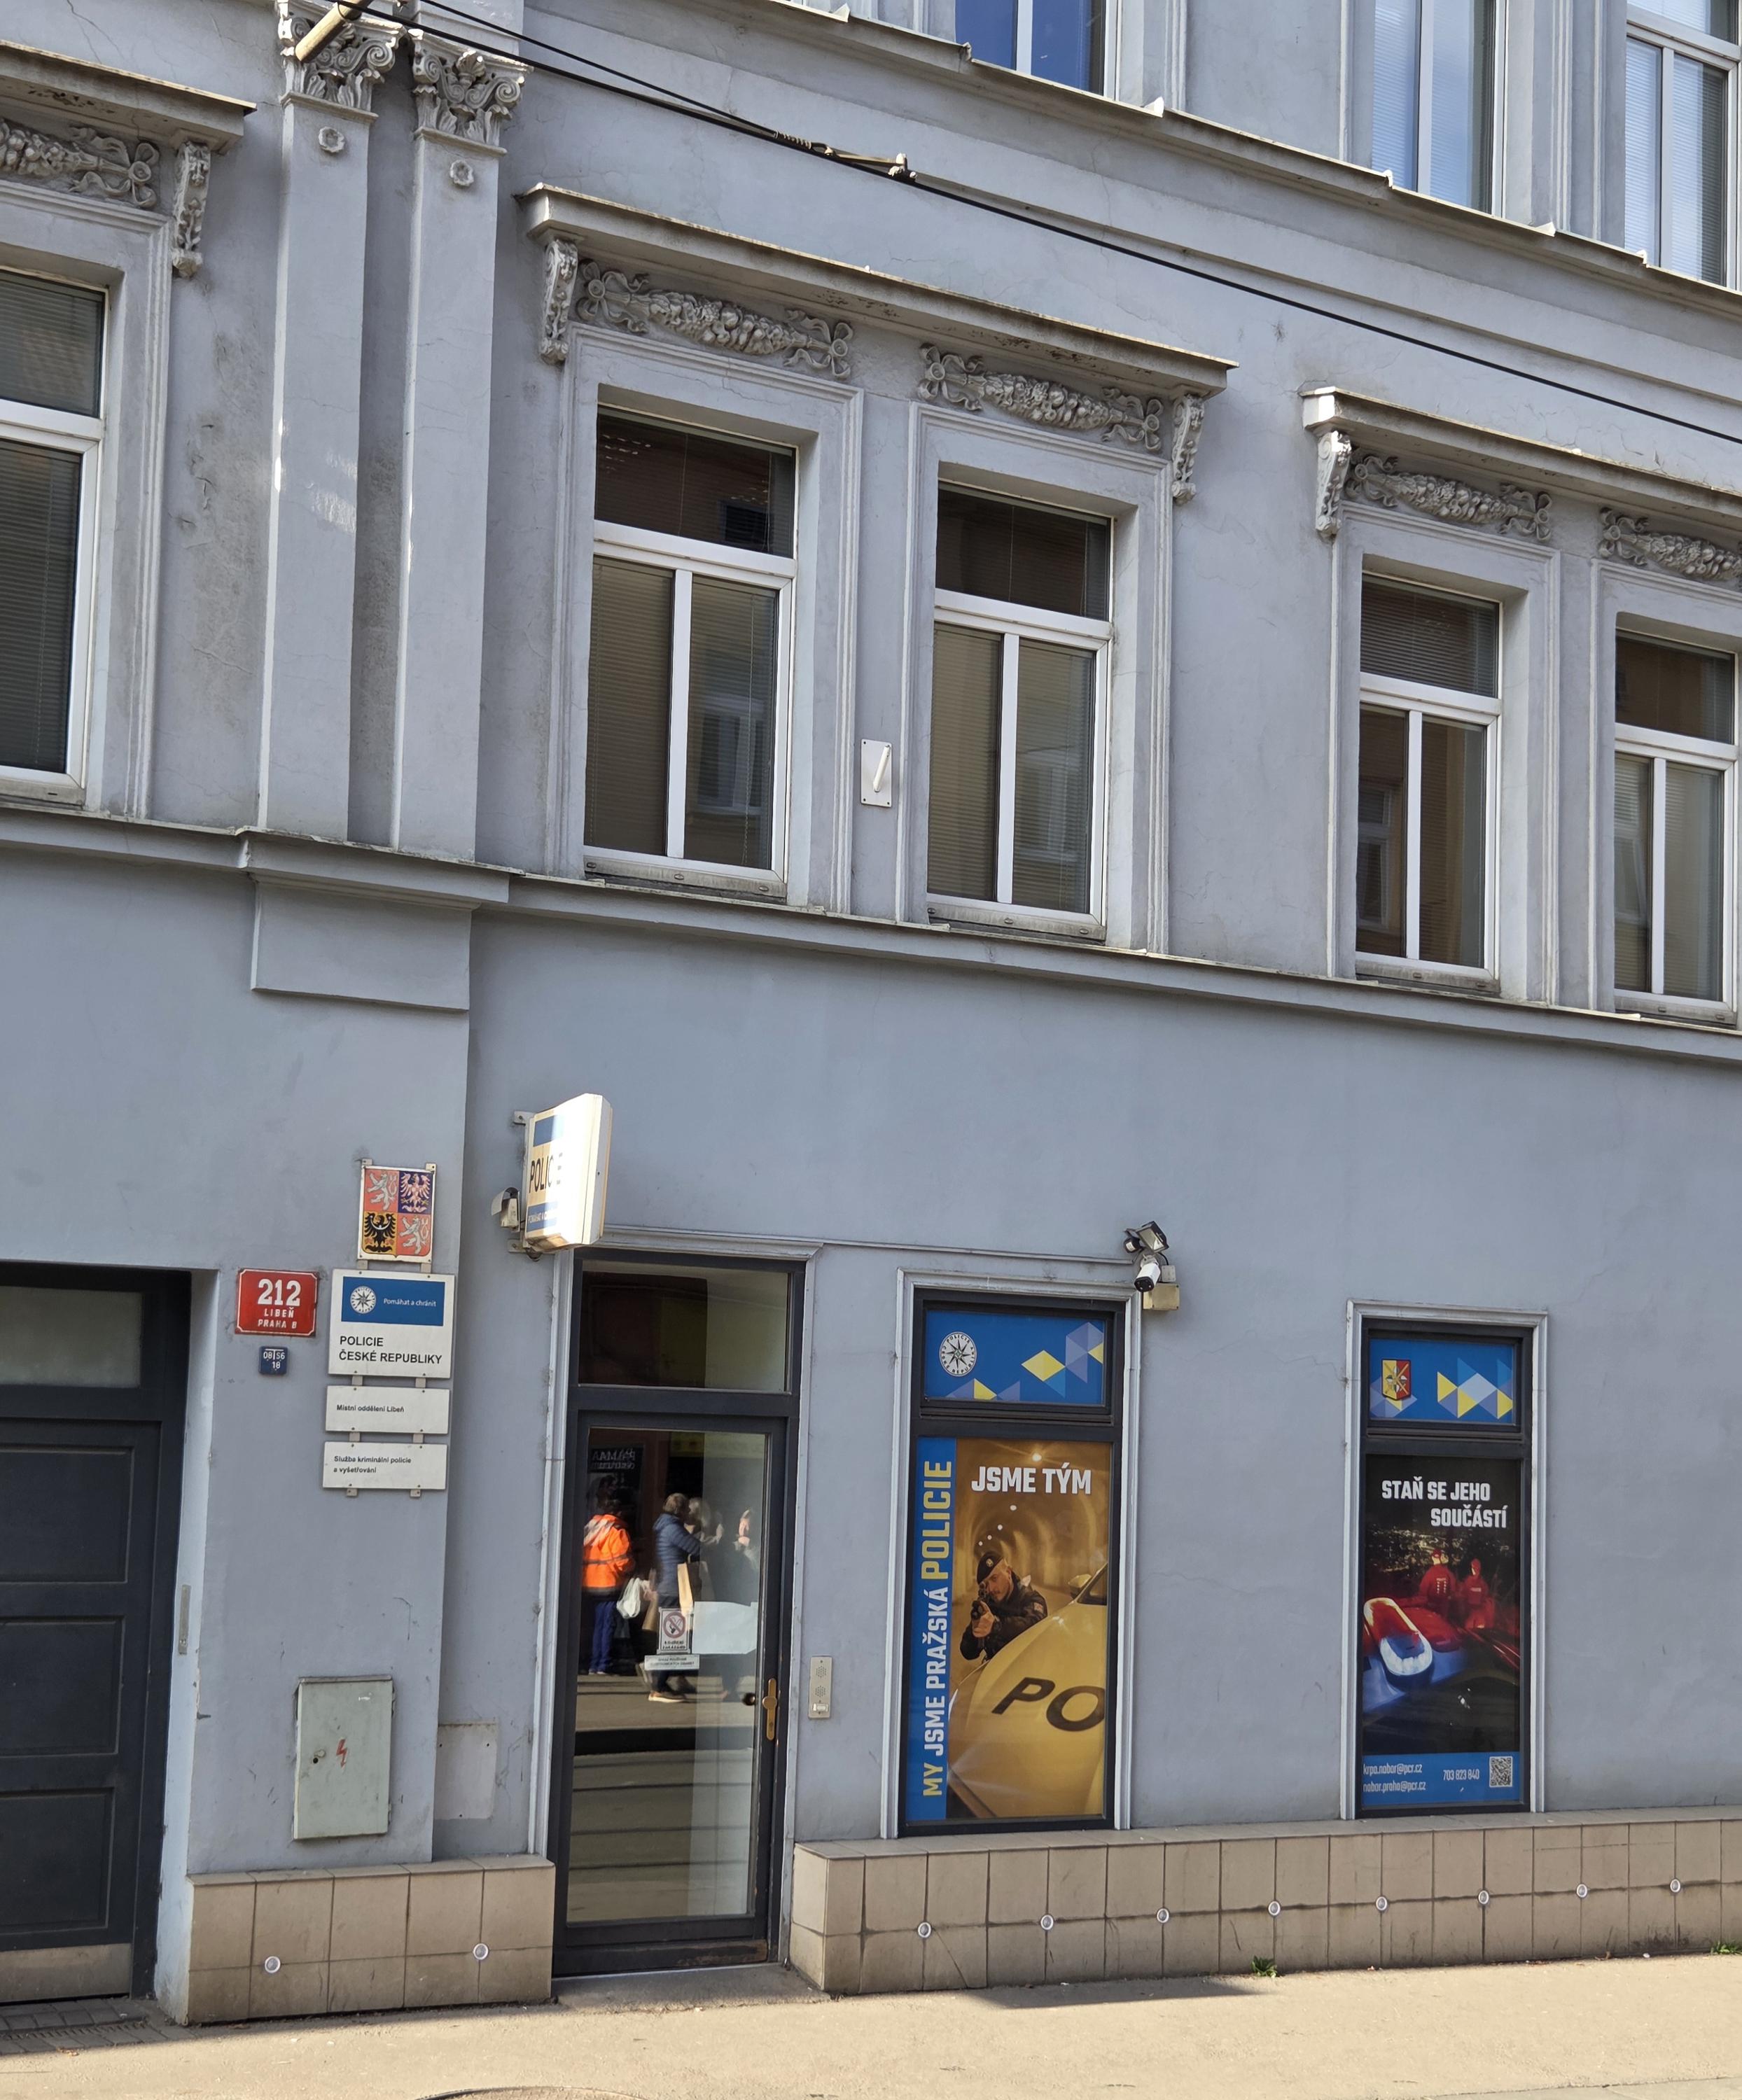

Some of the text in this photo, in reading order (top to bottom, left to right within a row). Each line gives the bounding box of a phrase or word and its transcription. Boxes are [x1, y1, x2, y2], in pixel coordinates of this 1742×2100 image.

[258, 1278, 301, 1306] 212
[258, 1319, 298, 1329] PRAHA 8
[264, 1307, 294, 1318] LIBEŇ
[340, 1336, 384, 1347] POLICIE
[339, 1349, 443, 1364] ČESKÉ REPUBLIKY
[971, 1462, 1092, 1494] JSME TÝM
[1381, 1476, 1491, 1501] STAŇ SE JEHO
[1430, 1504, 1509, 1528] SOUČÁSTÍ
[921, 1461, 952, 1796] MY JSME PRAŽSKÁ POLICIE
[991, 1676, 1106, 1732] PO
[1442, 1769, 1454, 1781] 703
